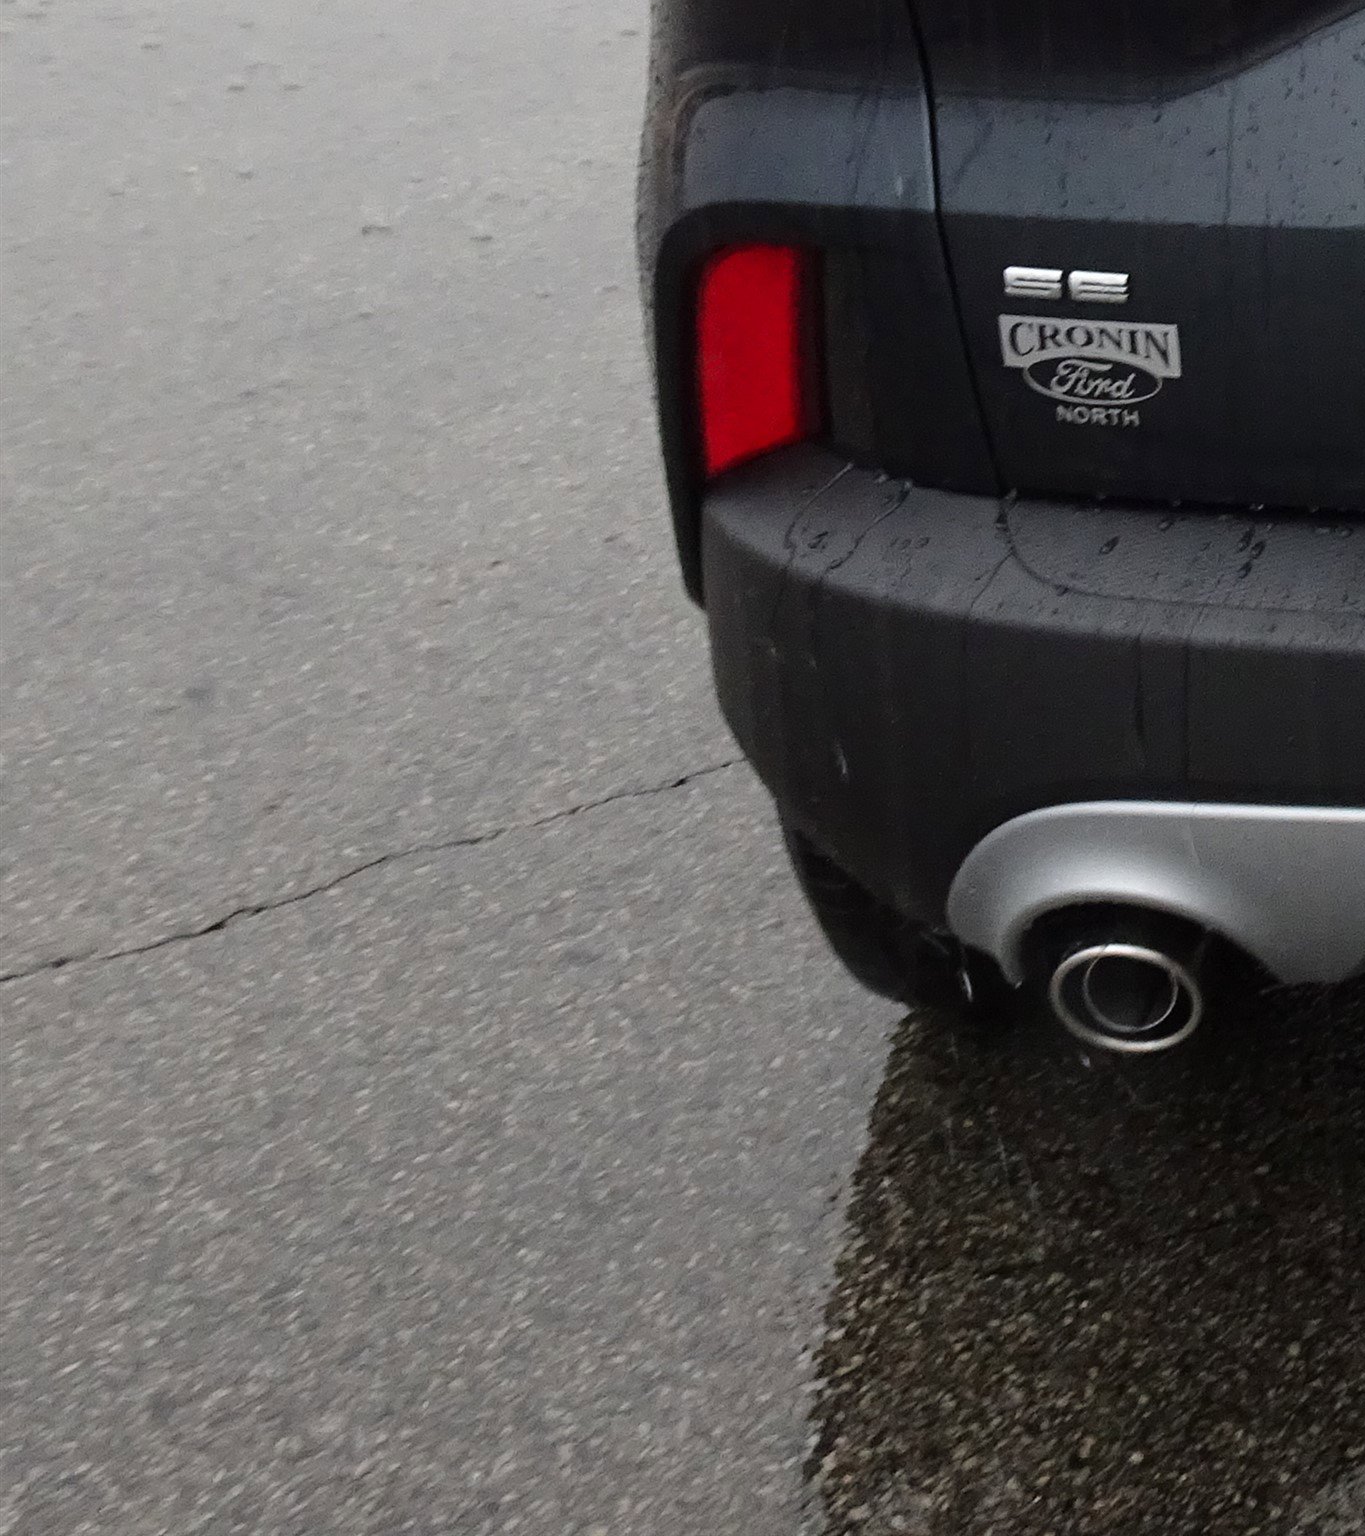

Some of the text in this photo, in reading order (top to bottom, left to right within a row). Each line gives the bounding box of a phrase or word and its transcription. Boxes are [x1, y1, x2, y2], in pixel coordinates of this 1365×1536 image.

[1003, 266, 1129, 304] SE
[1008, 321, 1172, 368] CRONIN
[1050, 358, 1137, 400] Ford
[1055, 404, 1140, 427] NORTH
